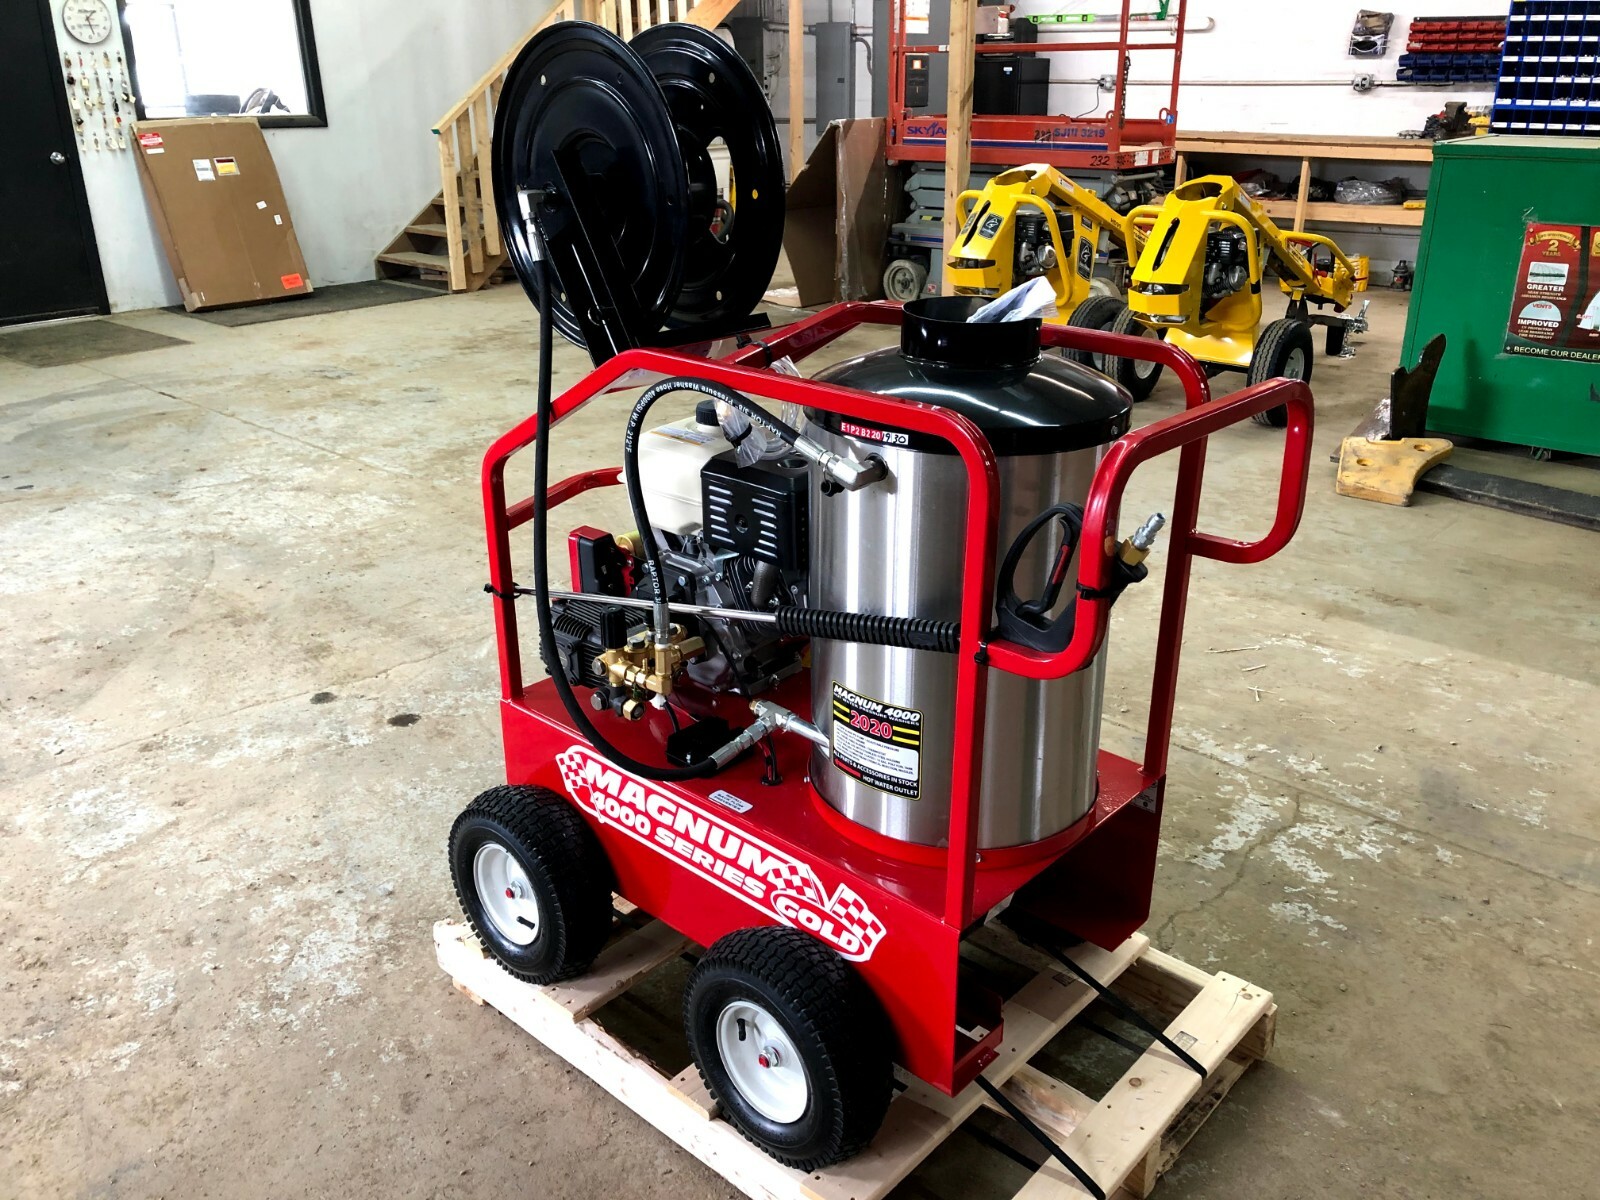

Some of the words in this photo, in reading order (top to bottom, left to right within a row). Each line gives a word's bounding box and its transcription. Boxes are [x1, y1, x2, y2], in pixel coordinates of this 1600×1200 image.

[907, 121, 946, 137] SKYJA
[1081, 128, 1105, 138] 3219
[1089, 155, 1110, 167] 232
[1547, 239, 1559, 252] 2
[1526, 283, 1565, 292] GREATER
[1517, 319, 1559, 328] IMPROVED
[1513, 345, 1549, 355] BECOME
[1550, 349, 1569, 357] OUR
[655, 382, 673, 393] Hose
[673, 381, 700, 393] Washer
[701, 385, 734, 405] Pressure
[648, 559, 661, 595] RAPTOR
[833, 684, 883, 713] MAGNUM
[884, 707, 920, 722] 4000
[850, 709, 893, 739] 2020
[857, 764, 890, 781] ACCESSORIES
[891, 775, 898, 783] IN
[898, 779, 918, 788] STOCK
[862, 774, 873, 783] HOT
[874, 779, 893, 791] WATER
[894, 786, 918, 797] OUTLET
[584, 758, 779, 882] MAGNUM
[590, 790, 652, 836] 4000
[654, 826, 767, 900] SERIES
[776, 896, 861, 953] GOLD
